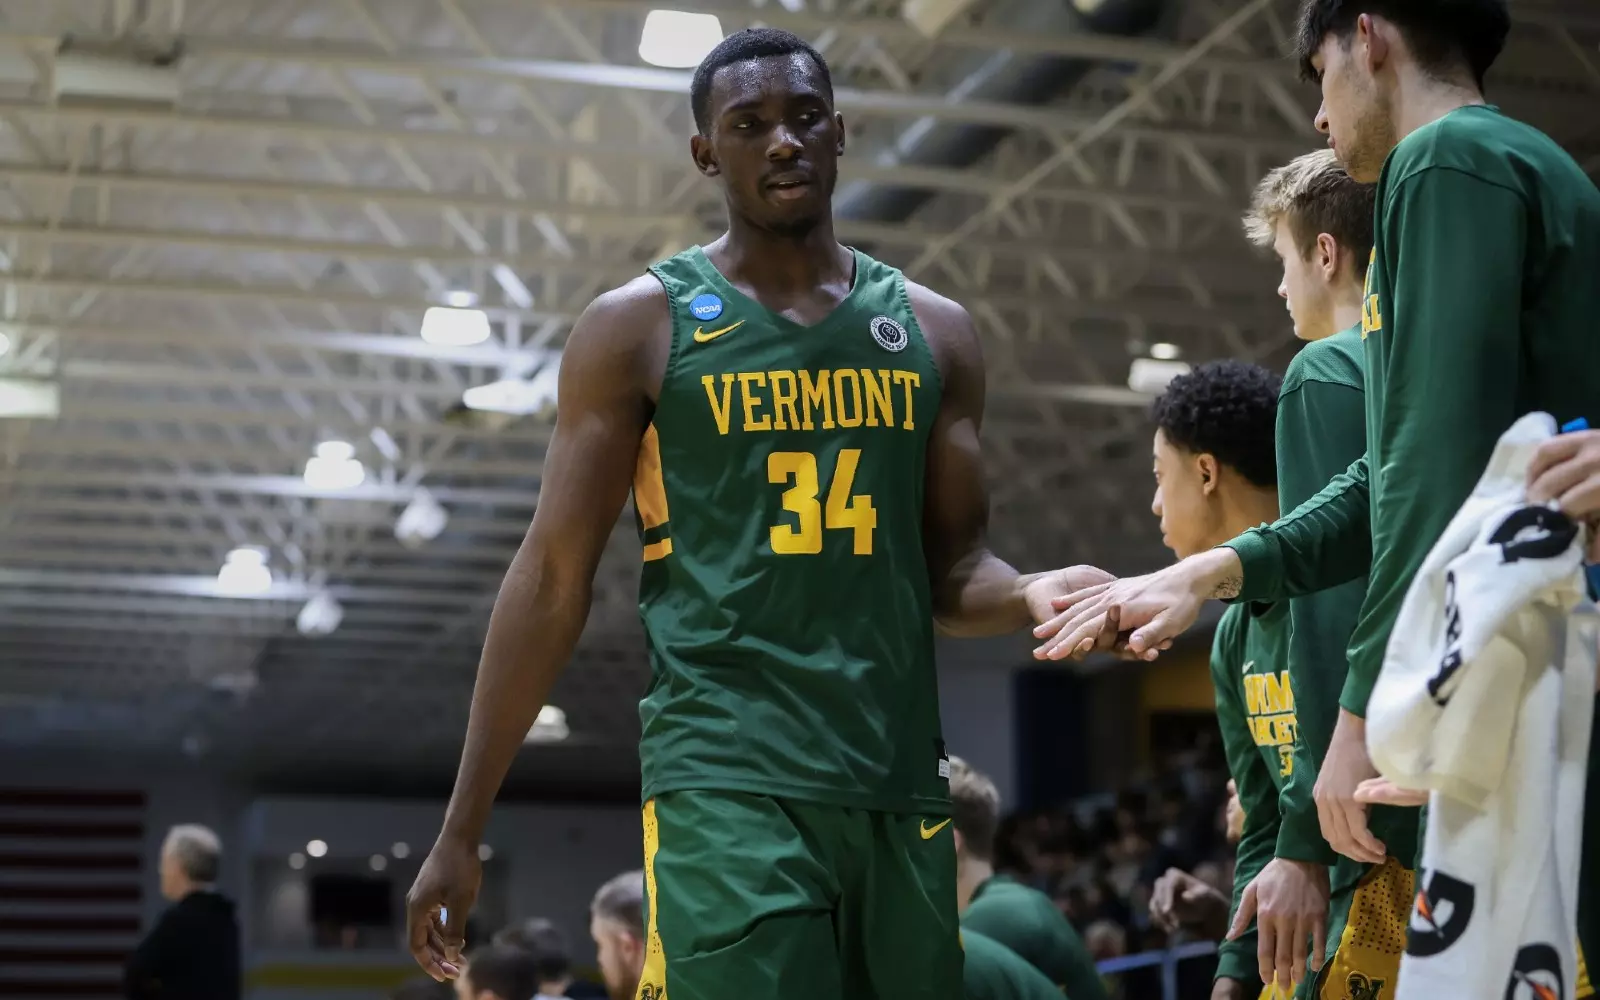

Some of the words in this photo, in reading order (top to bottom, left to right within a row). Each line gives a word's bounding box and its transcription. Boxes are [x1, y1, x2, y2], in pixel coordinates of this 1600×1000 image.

[695, 304, 721, 314] NCAA
[701, 368, 921, 436] VERMONT
[767, 449, 877, 555] 34
